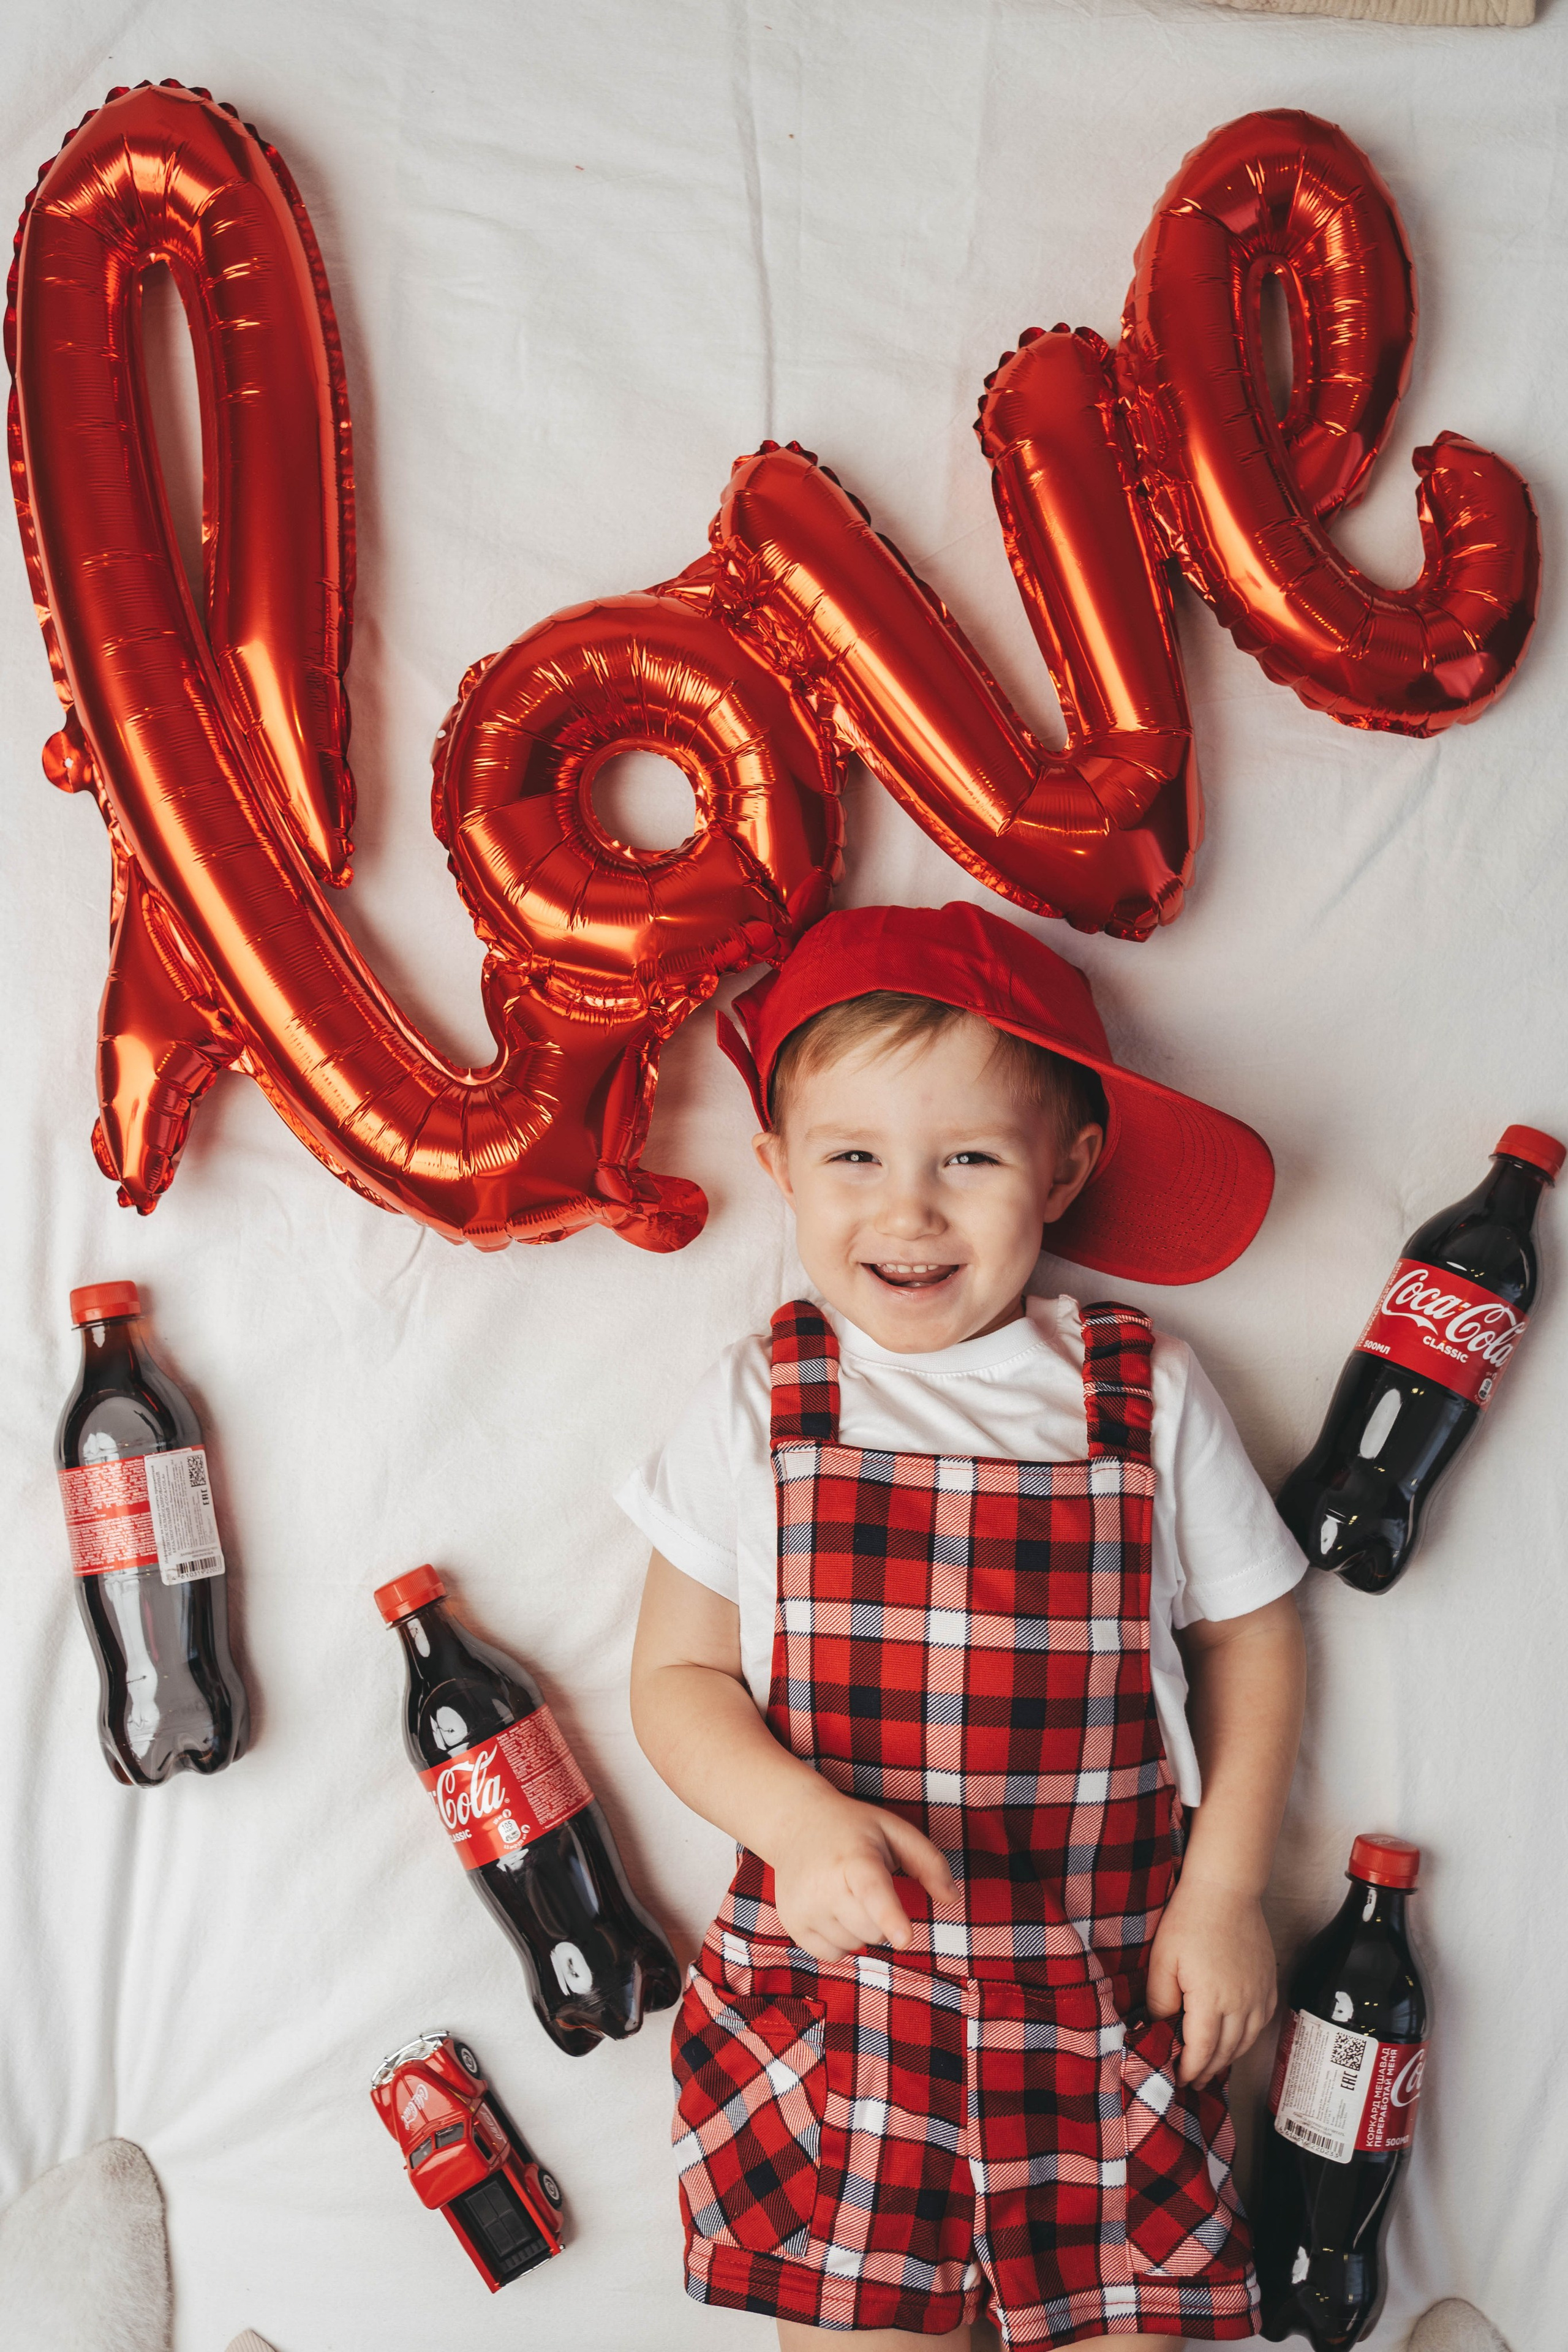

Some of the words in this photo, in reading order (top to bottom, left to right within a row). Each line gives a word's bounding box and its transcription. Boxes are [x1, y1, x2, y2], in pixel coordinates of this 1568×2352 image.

[1381, 1268, 1525, 1367] Coca-Cola
[1423, 1336, 1469, 1363] CLASSIC
[501, 1821, 513, 1830] 105
[1366, 2101, 1381, 2147] КОРКАРД
[1374, 2048, 1391, 2101] МЕШАВАД
[1374, 2078, 1392, 2147] ПЕРЕРАБОТАЙ
[1387, 2049, 1398, 2076] МЕНЯ
